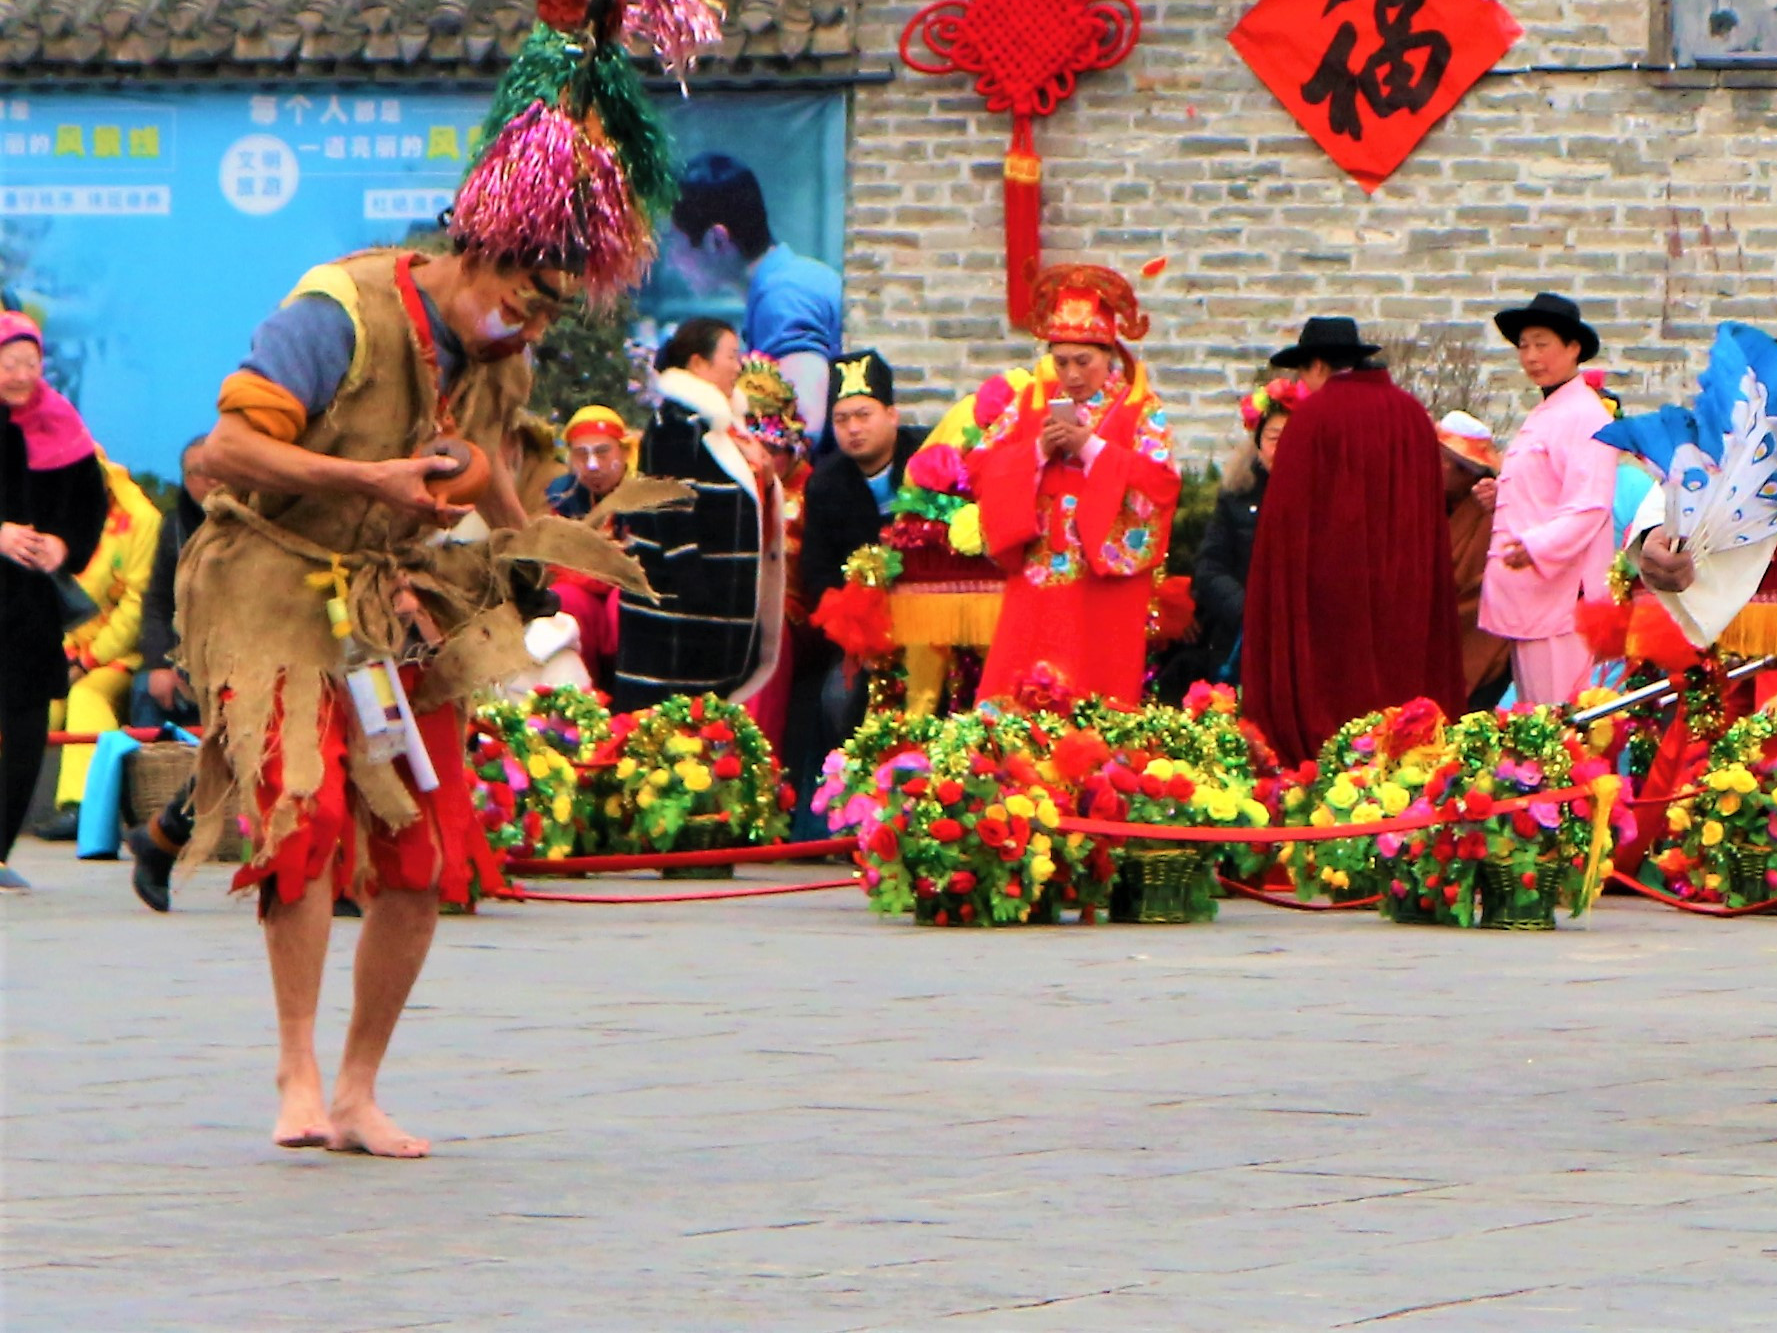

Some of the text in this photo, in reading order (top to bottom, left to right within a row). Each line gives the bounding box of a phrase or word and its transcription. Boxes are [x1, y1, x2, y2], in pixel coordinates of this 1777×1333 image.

[250, 94, 401, 126] 每个人都是
